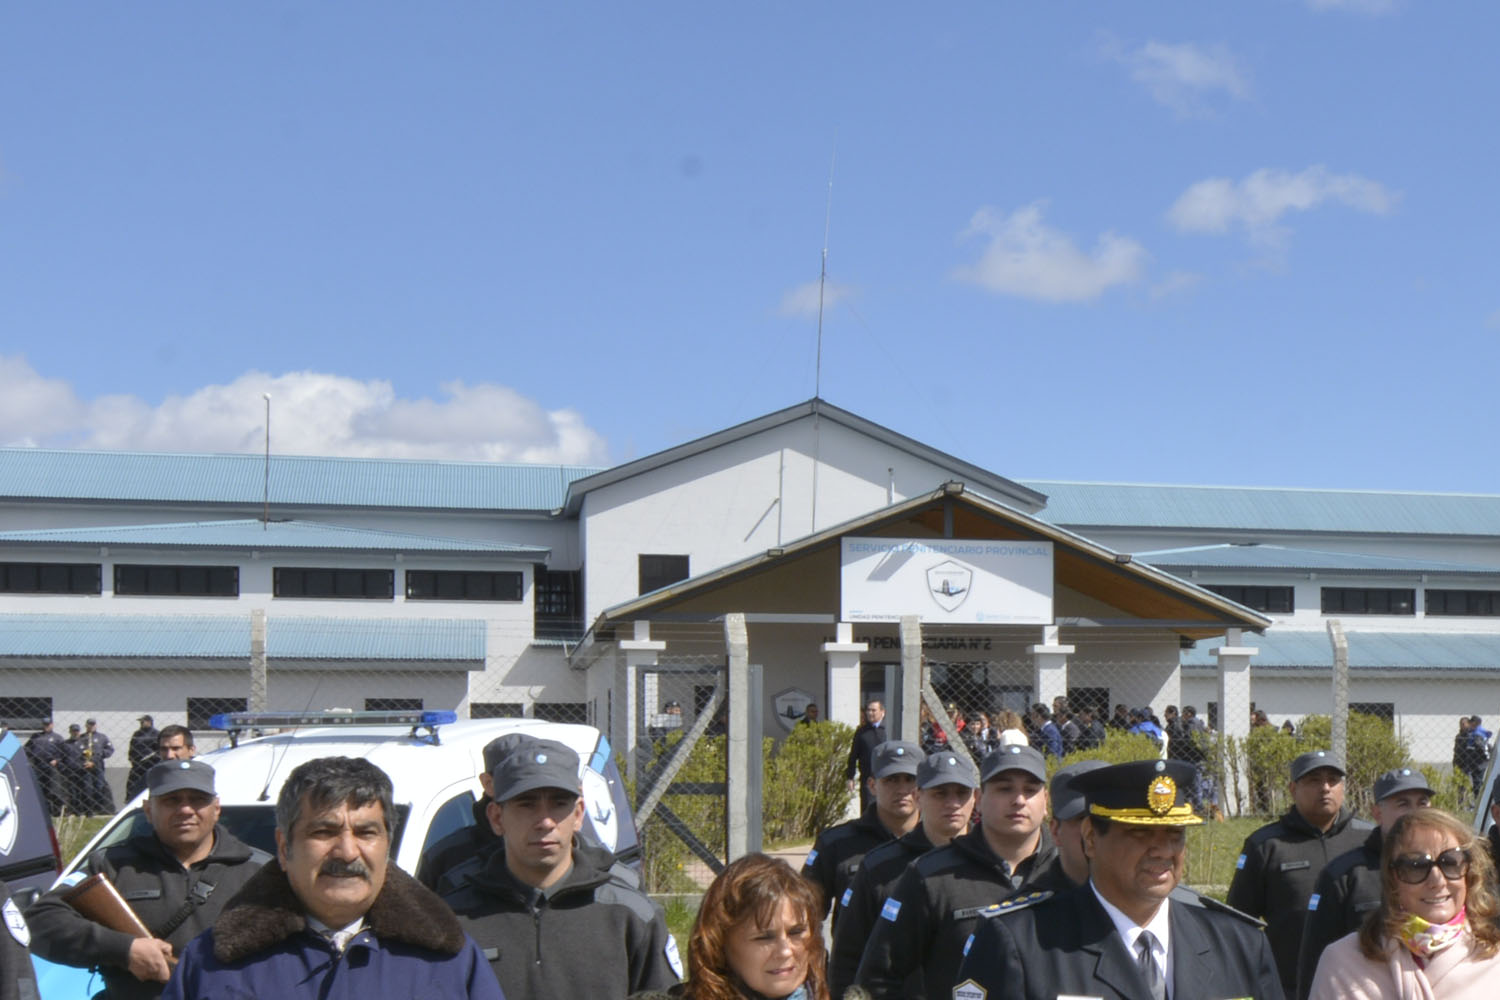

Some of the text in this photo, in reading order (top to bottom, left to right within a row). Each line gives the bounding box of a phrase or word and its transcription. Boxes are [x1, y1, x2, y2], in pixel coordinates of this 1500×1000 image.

[848, 543, 1050, 556] SERVICIO PENITENCIARIO PROVINCIAL
